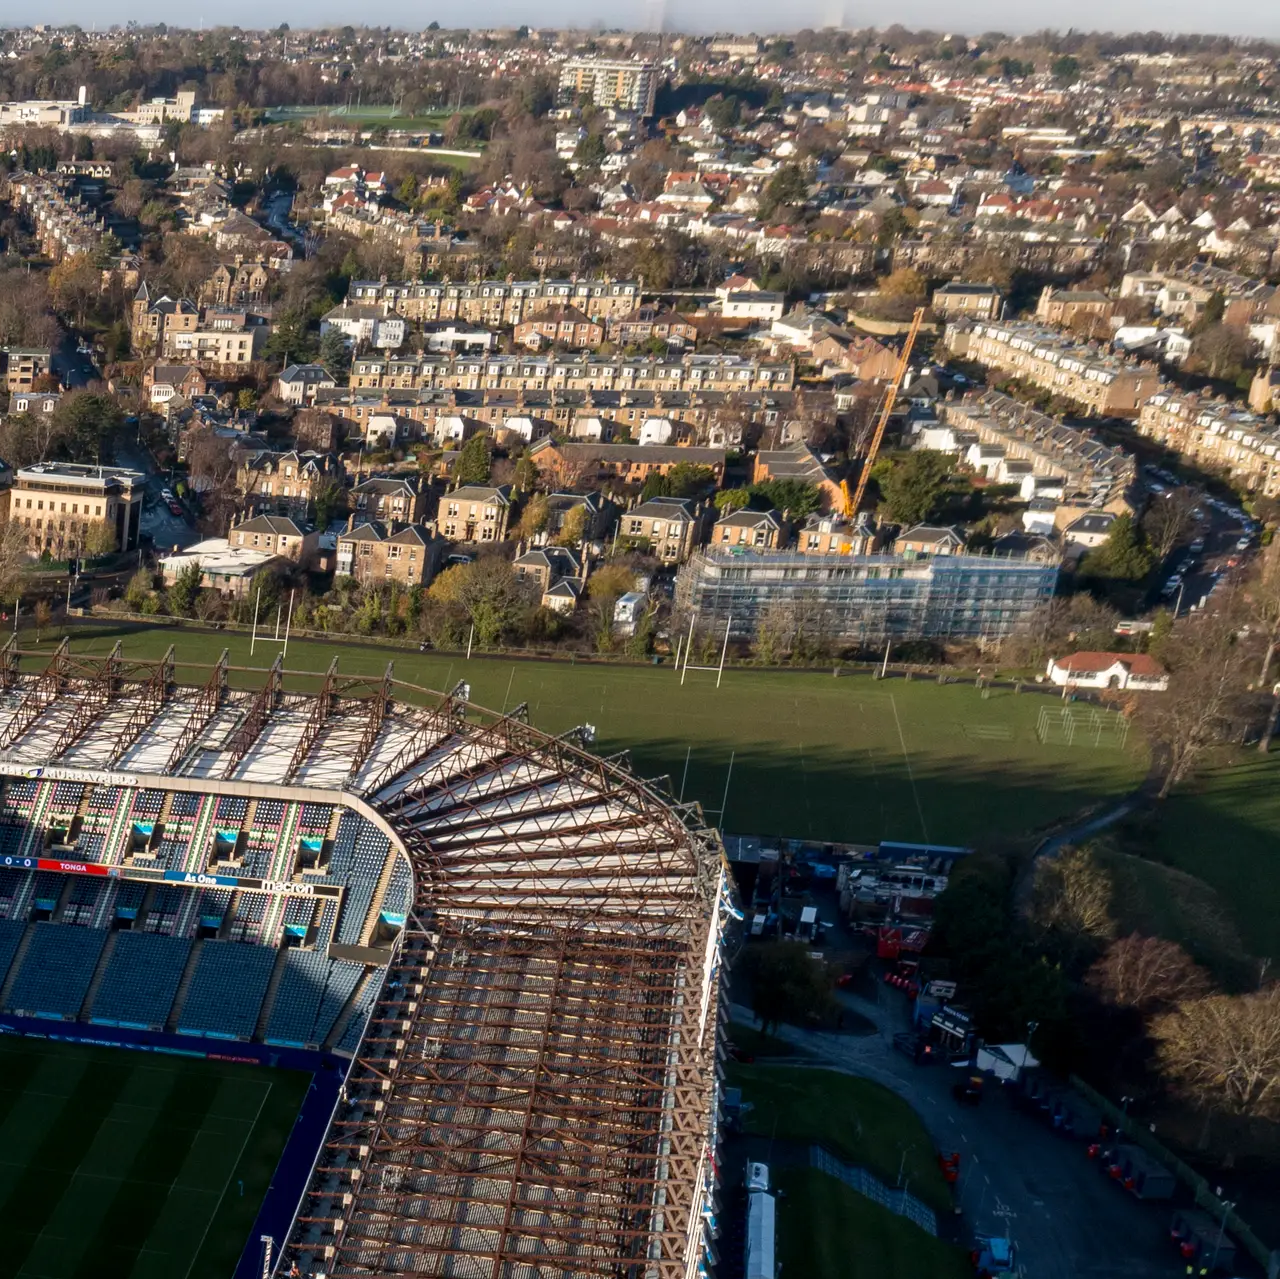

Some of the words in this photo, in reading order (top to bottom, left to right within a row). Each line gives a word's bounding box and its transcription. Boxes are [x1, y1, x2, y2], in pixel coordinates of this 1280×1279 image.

[46, 767, 138, 786] MURRAYFIELD
[5, 856, 12, 865] 0
[24, 858, 31, 867] 0
[60, 862, 87, 872] TONGA
[184, 872, 196, 883] As
[197, 874, 217, 885] One
[261, 879, 314, 894] macron
